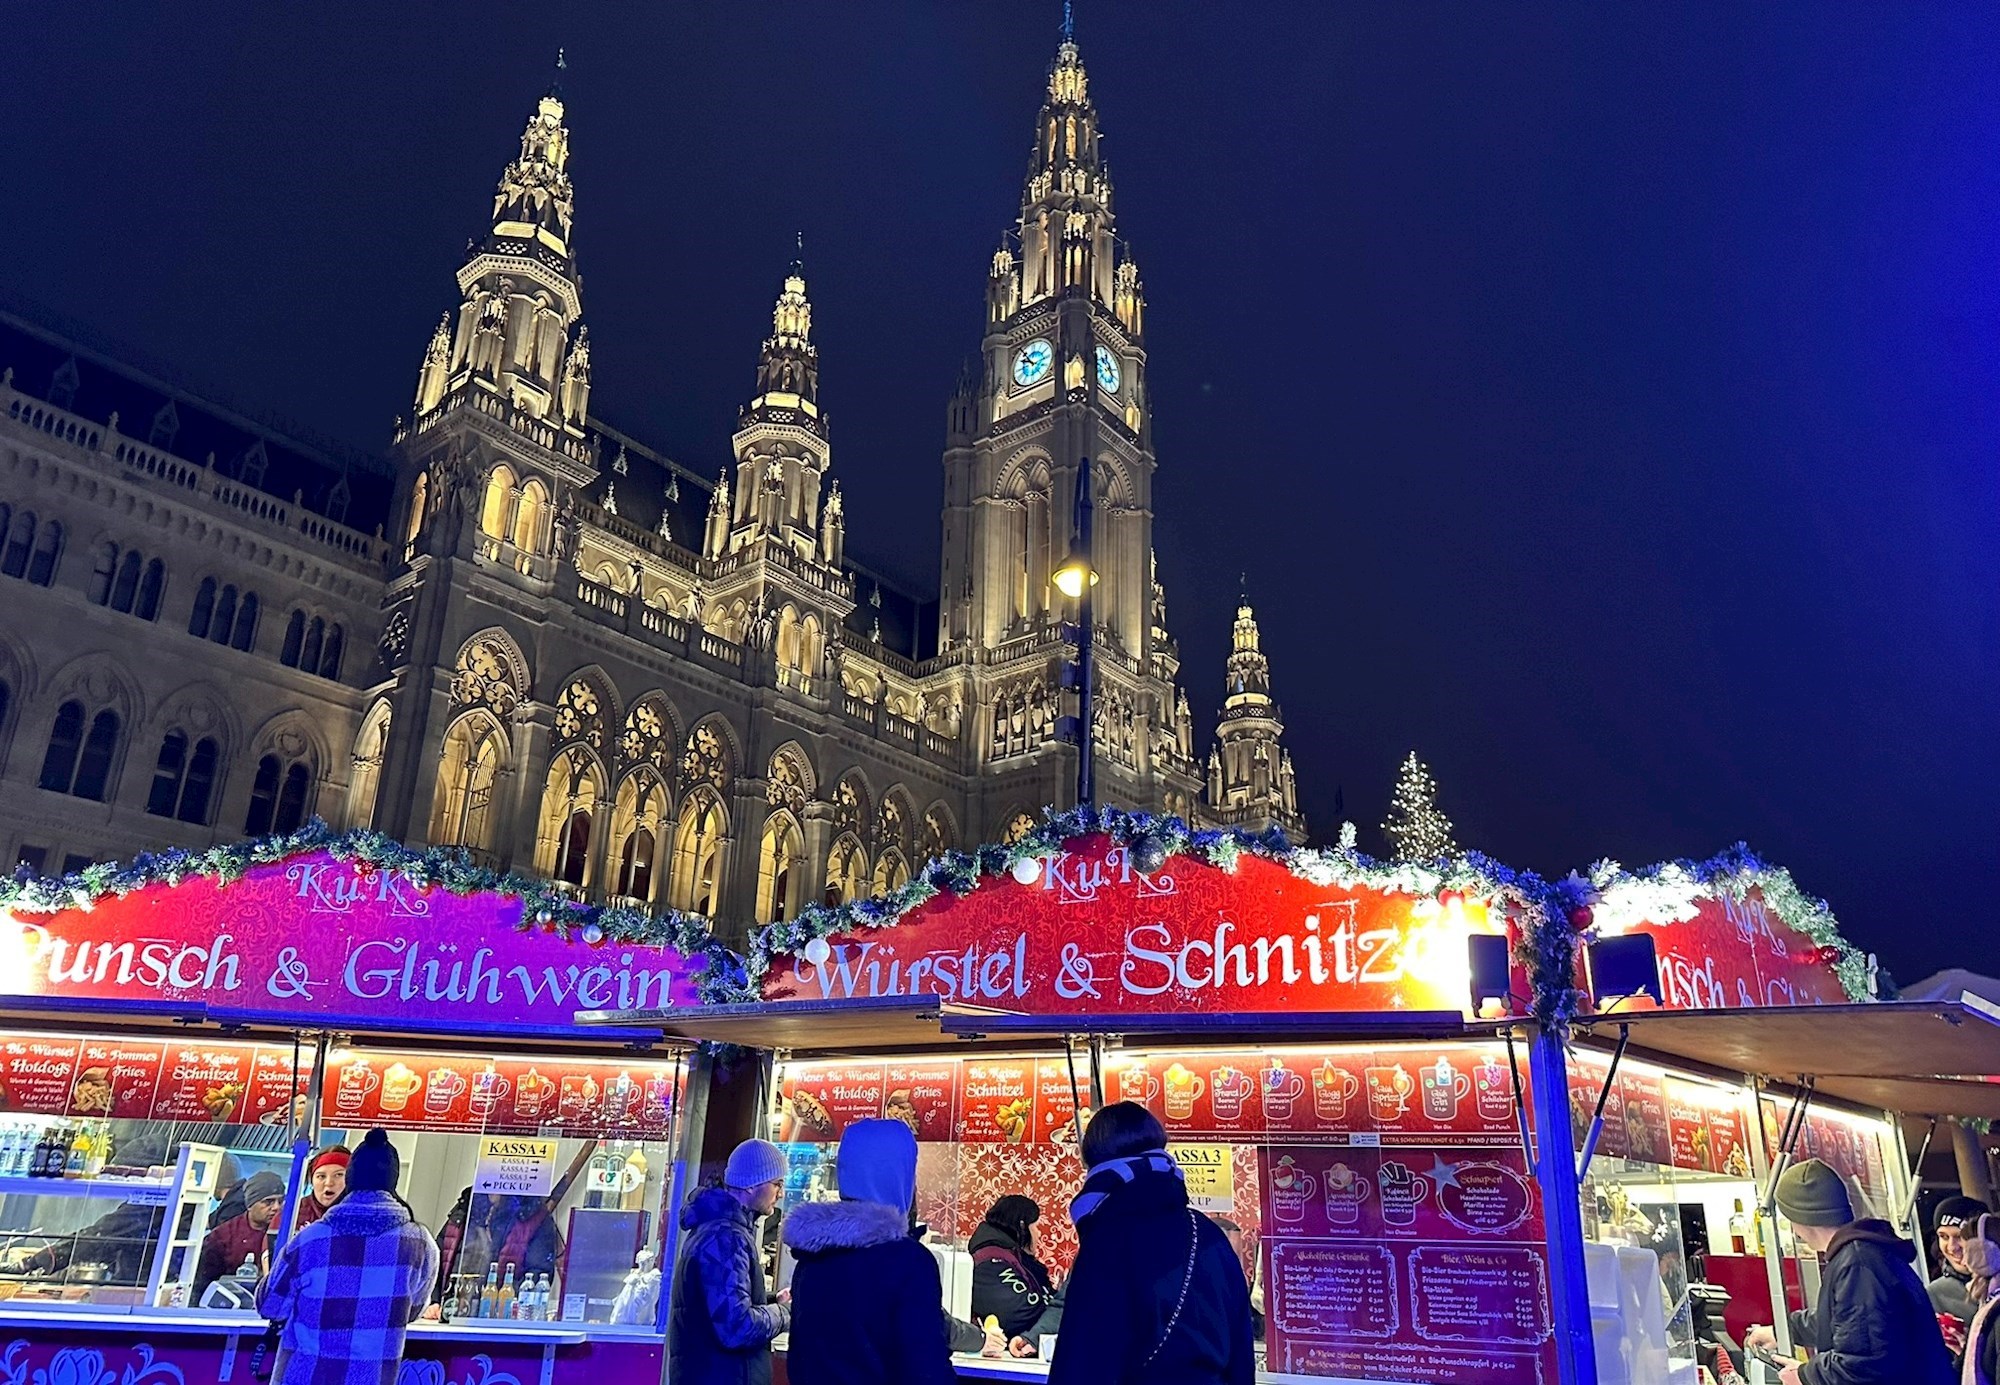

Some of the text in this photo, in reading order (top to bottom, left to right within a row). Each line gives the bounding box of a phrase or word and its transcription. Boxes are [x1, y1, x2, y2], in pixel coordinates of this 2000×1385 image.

[794, 908, 1405, 1000] Würstel & Schnitz
[267, 946, 314, 1001] &
[344, 937, 675, 1010] Glühwein
[1656, 954, 1726, 1008] nsch
[6, 1043, 76, 1057] Bio Würstel
[87, 1047, 158, 1062] Bio Pommes
[178, 1051, 199, 1063] Bio
[10, 1059, 71, 1078] Hotdogs
[172, 1065, 239, 1082] Schnitzel
[827, 1071, 843, 1082] Bio
[845, 1070, 881, 1082] Würstel
[890, 1070, 950, 1082] Bio Pommes
[819, 1086, 880, 1102] & Hotdogs
[913, 1086, 942, 1098] Frites
[966, 1082, 1024, 1098] Schnitzel
[1587, 1088, 1621, 1112] Hoogs
[489, 1142, 547, 1156] KASSA 4
[1172, 1149, 1221, 1162] ASSA 3
[1185, 1167, 1200, 1175] SSA
[492, 1182, 532, 1191] PICK UP
[1186, 1177, 1200, 1185] SSA
[1466, 1186, 1500, 1194] Schokolade
[1198, 1196, 1212, 1206] UP
[1422, 1266, 1446, 1274] Bio-Bier
